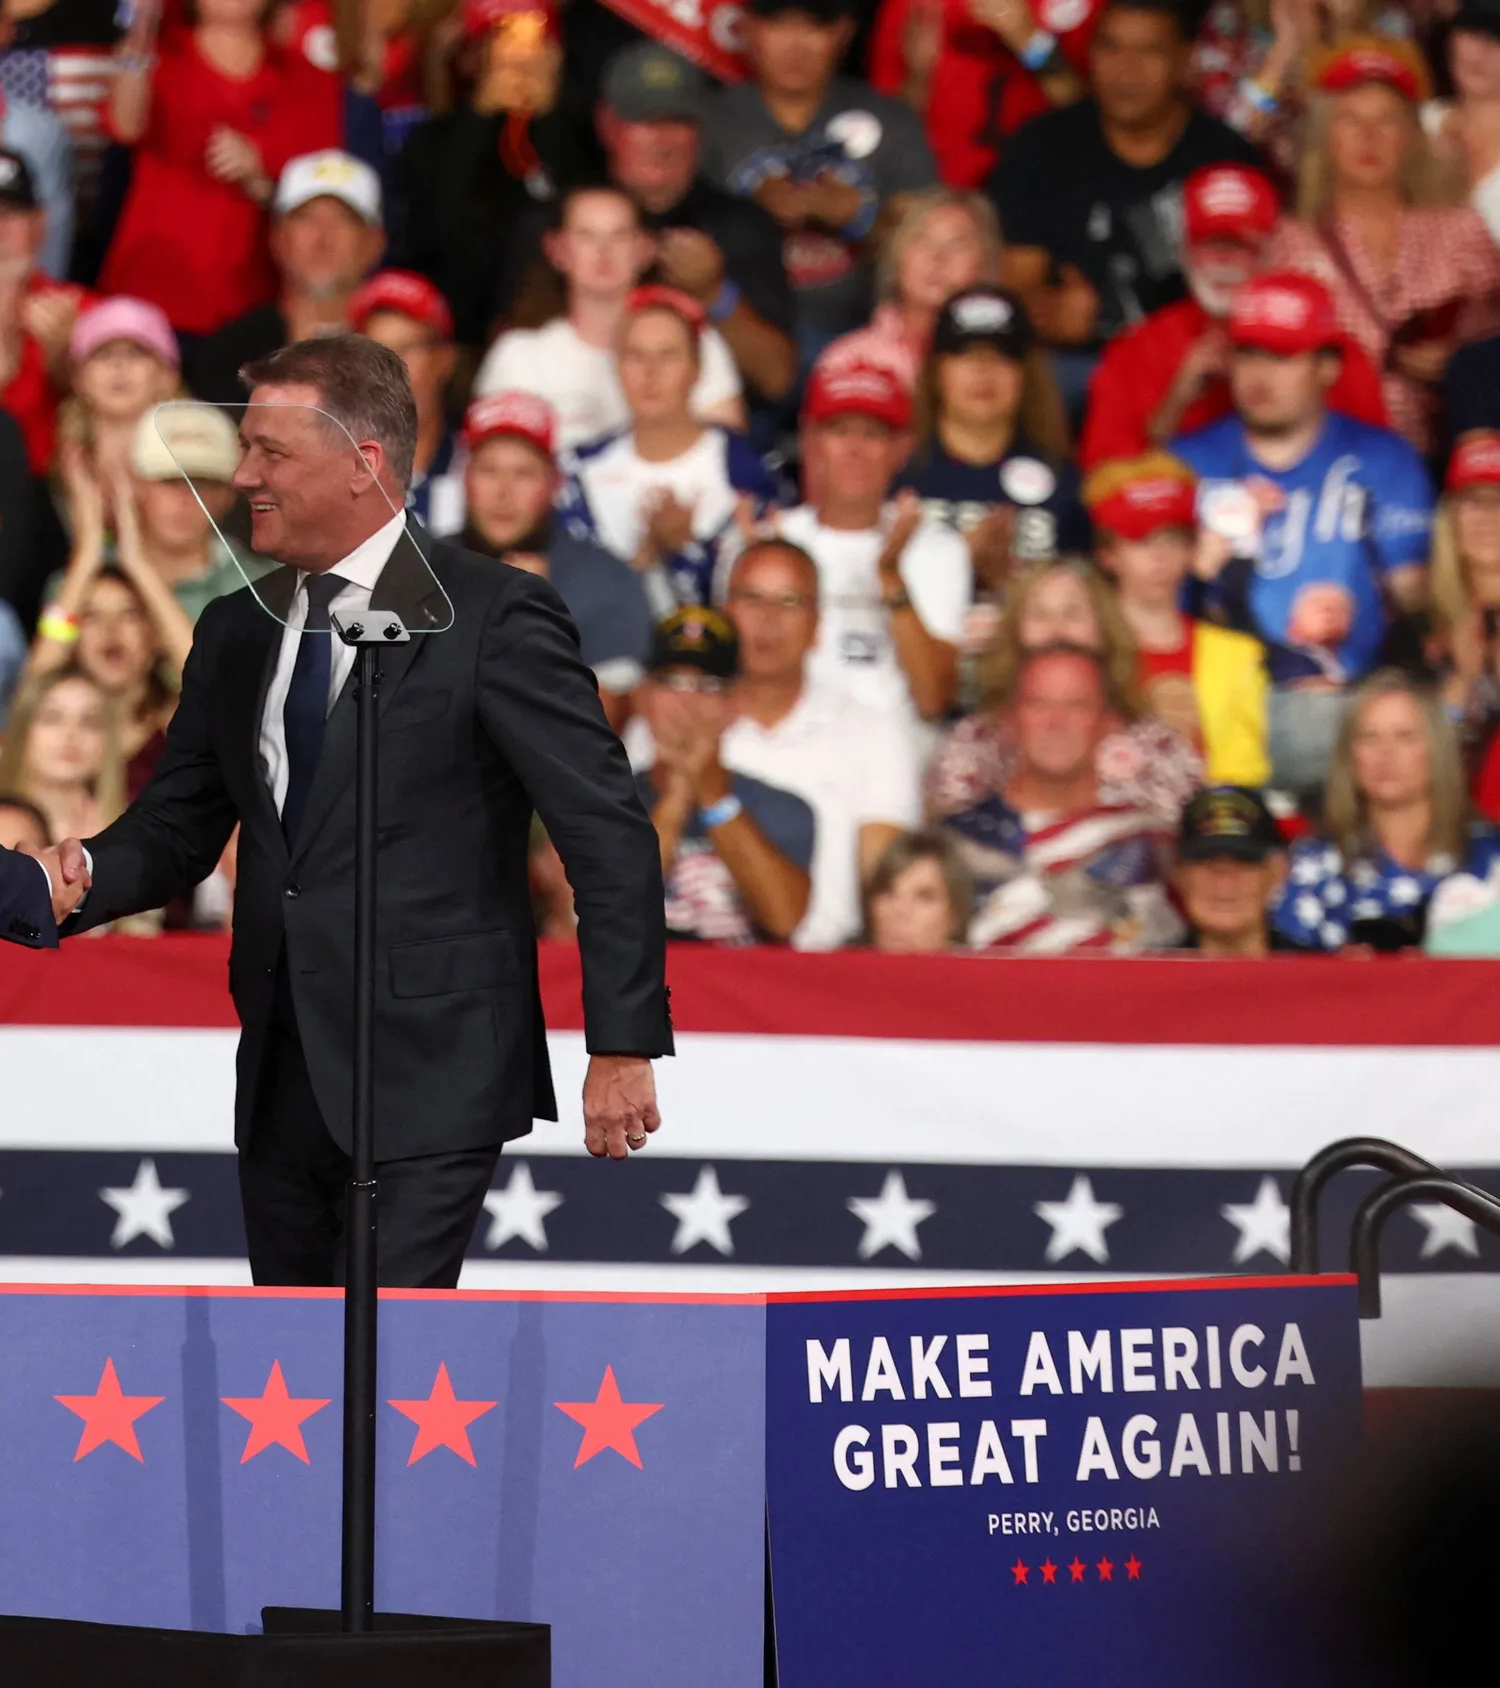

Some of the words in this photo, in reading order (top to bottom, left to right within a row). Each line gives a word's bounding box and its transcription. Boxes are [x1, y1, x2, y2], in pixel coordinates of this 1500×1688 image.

[806, 1334, 993, 1403] MAKE
[1019, 1322, 1316, 1396] AMERICA
[833, 1418, 1048, 1491] GREAT
[1075, 1409, 1301, 1482] AGAIN!
[988, 1511, 1059, 1536] PERRY,
[1066, 1507, 1160, 1532] GEORGIA
